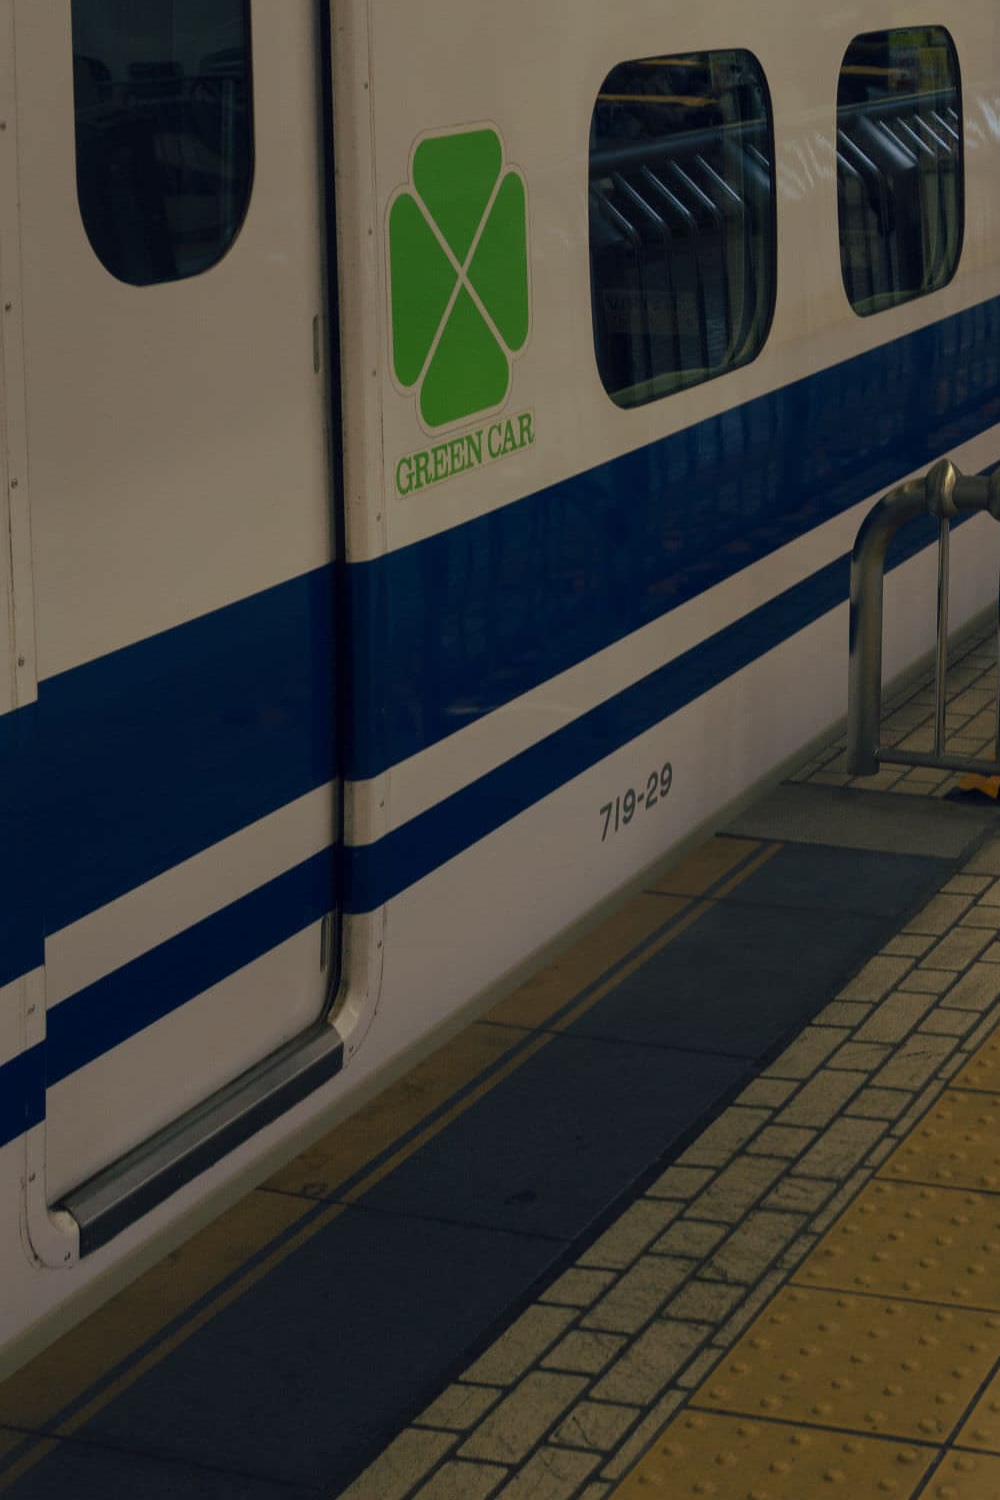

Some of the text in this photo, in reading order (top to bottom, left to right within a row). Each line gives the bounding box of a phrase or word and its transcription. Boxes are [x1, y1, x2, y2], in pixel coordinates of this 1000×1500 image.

[396, 412, 535, 495] GREEN CAR
[599, 761, 673, 842] 719-29
